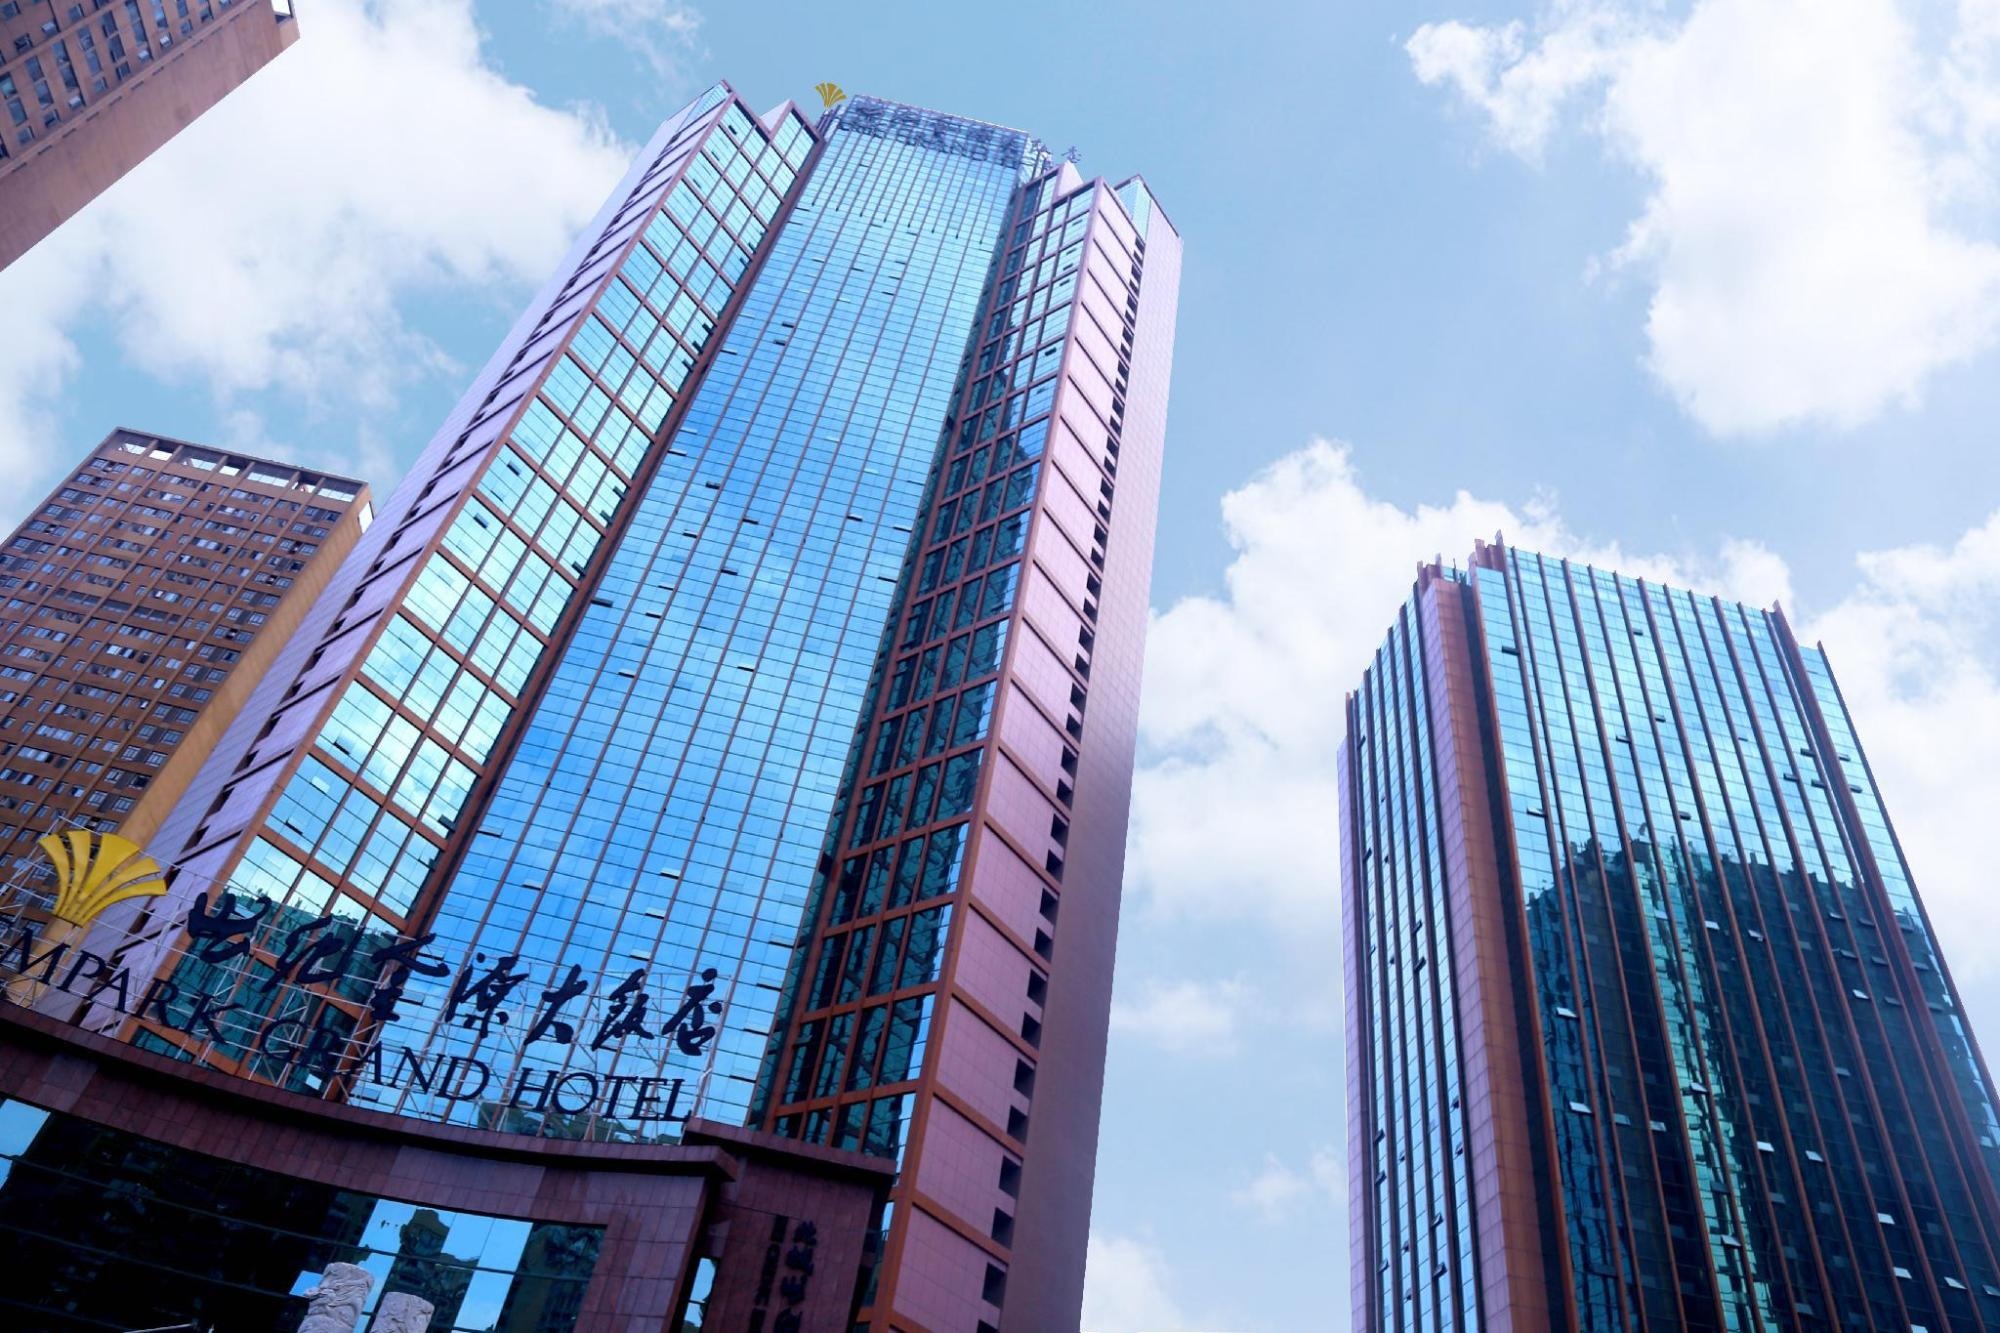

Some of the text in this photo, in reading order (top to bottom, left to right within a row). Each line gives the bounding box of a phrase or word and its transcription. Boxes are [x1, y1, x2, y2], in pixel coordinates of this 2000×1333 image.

[0, 927, 692, 1123] MPARK GRAND HOTEL
